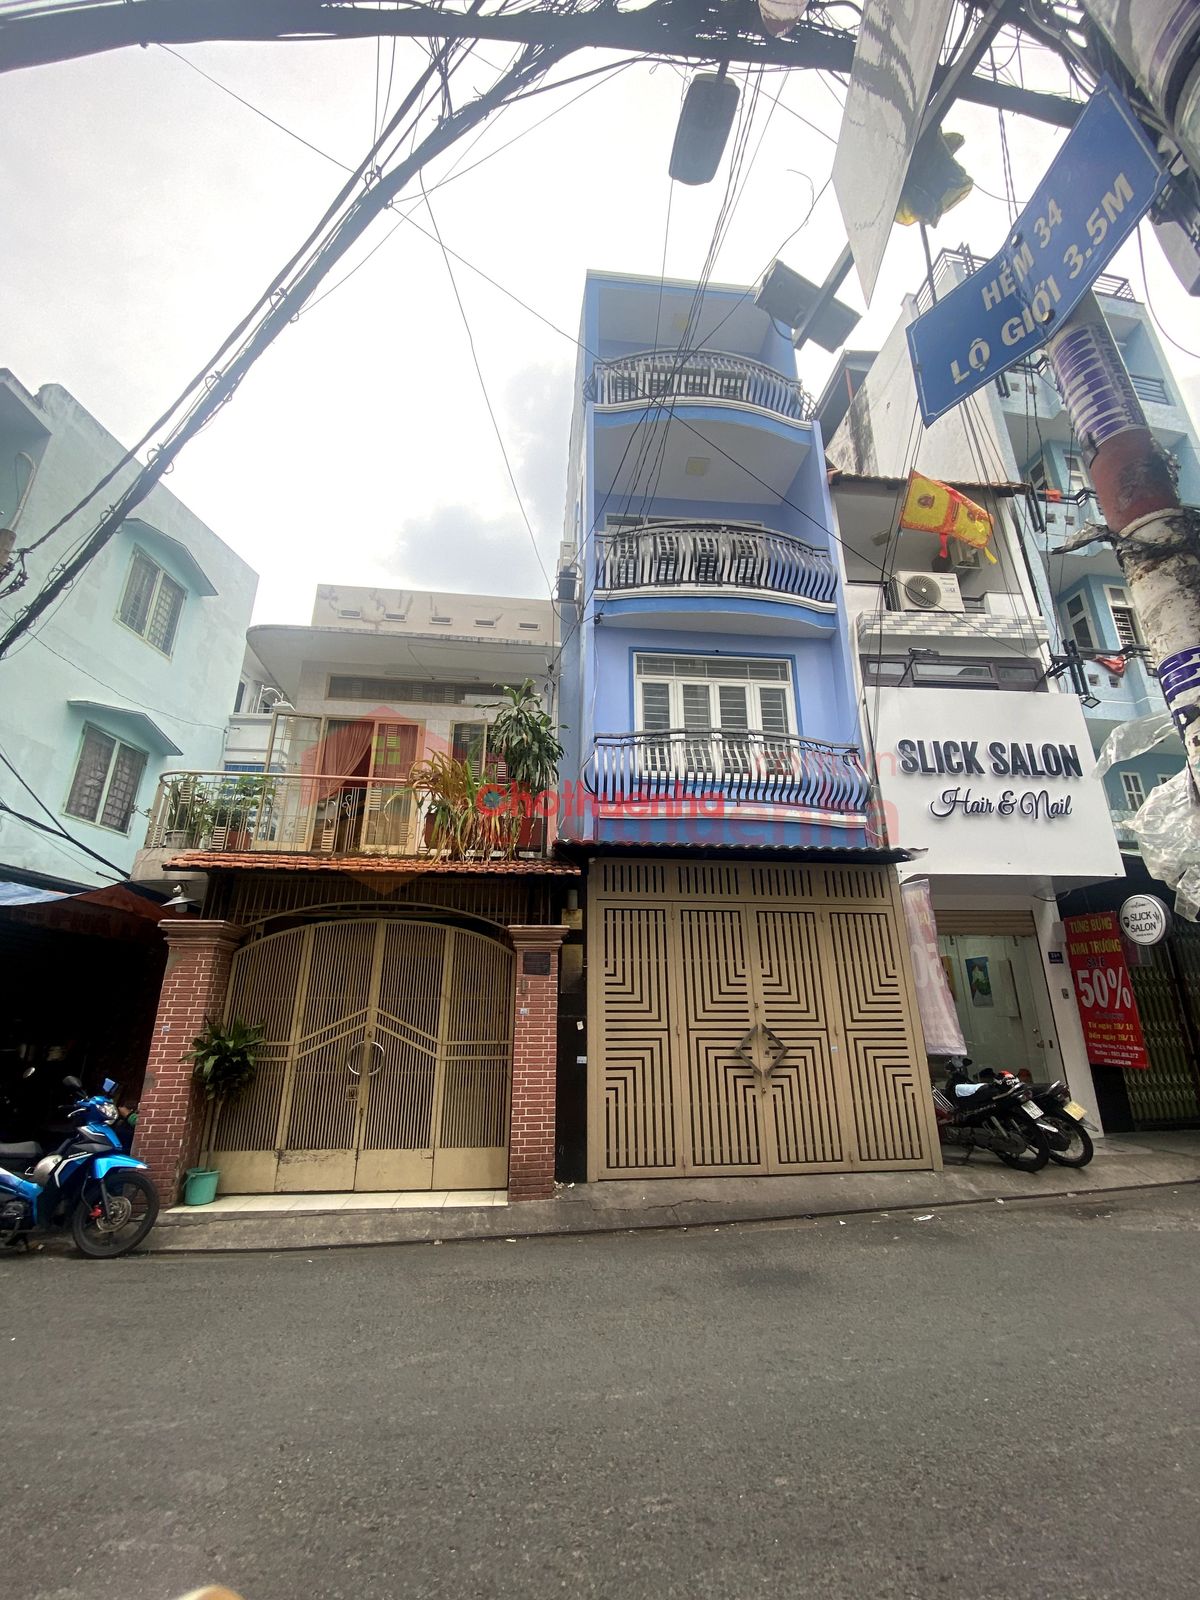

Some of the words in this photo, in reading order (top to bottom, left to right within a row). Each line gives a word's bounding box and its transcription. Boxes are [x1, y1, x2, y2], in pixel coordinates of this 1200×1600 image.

[980, 241, 1035, 312] HẺM
[1033, 198, 1063, 249] 34
[950, 337, 991, 385] LỘ
[1001, 275, 1062, 347] GIỚI
[1062, 172, 1136, 280] 3.5M
[897, 738, 985, 776] SLICK
[988, 741, 1083, 777] SALON
[930, 786, 994, 818] Hair
[998, 790, 1017, 816] &
[1020, 790, 1072, 820] Nail
[1130, 911, 1152, 922] SLICK
[1130, 922, 1156, 933] SALON
[1077, 967, 1131, 1009] 50%
